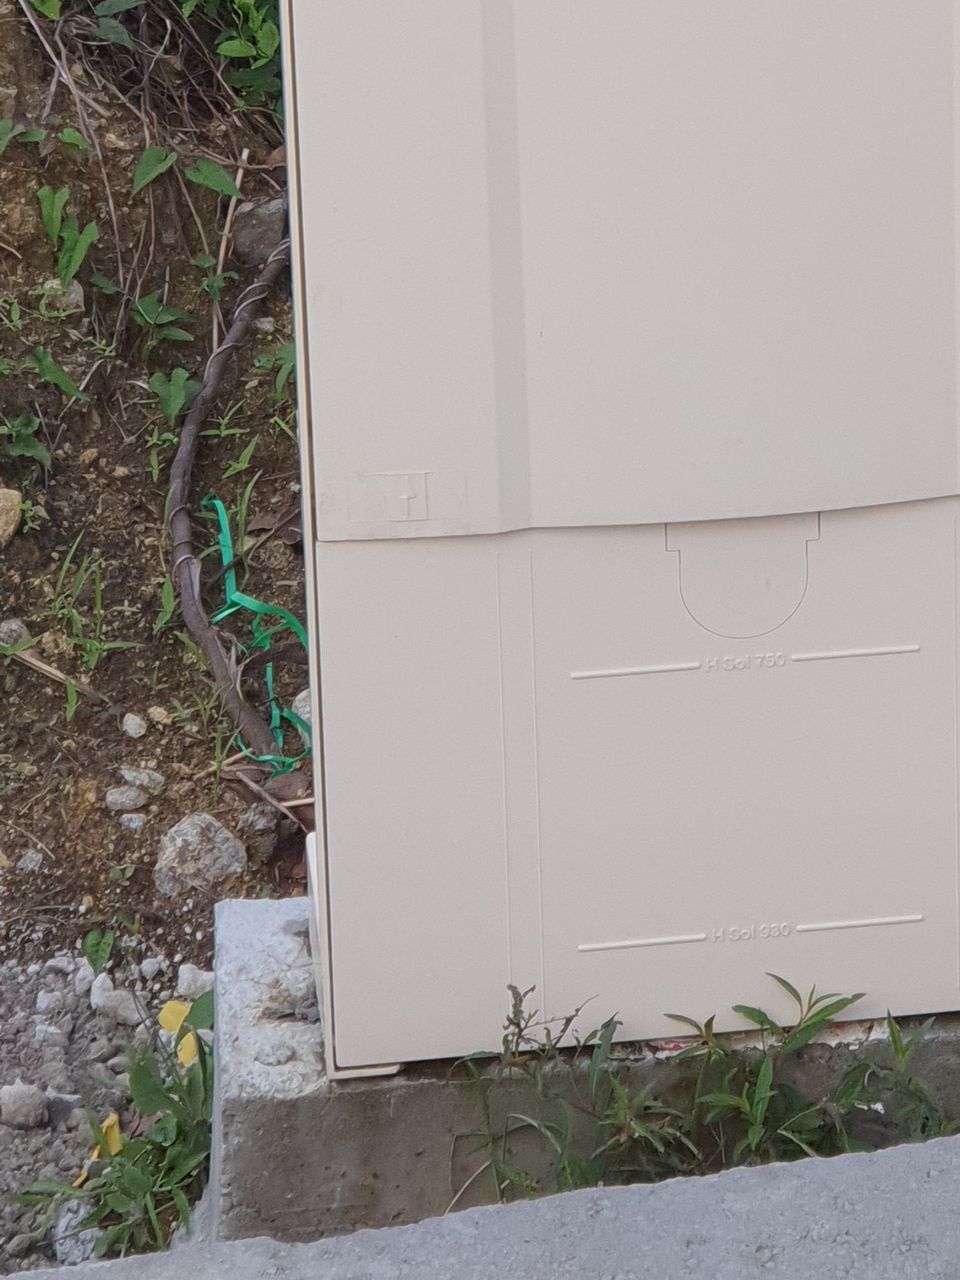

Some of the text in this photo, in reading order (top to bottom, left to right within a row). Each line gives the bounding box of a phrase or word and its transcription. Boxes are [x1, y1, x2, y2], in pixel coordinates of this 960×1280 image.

[705, 652, 786, 673] H Sol 750
[711, 926, 724, 943] H
[728, 924, 755, 941] Sol
